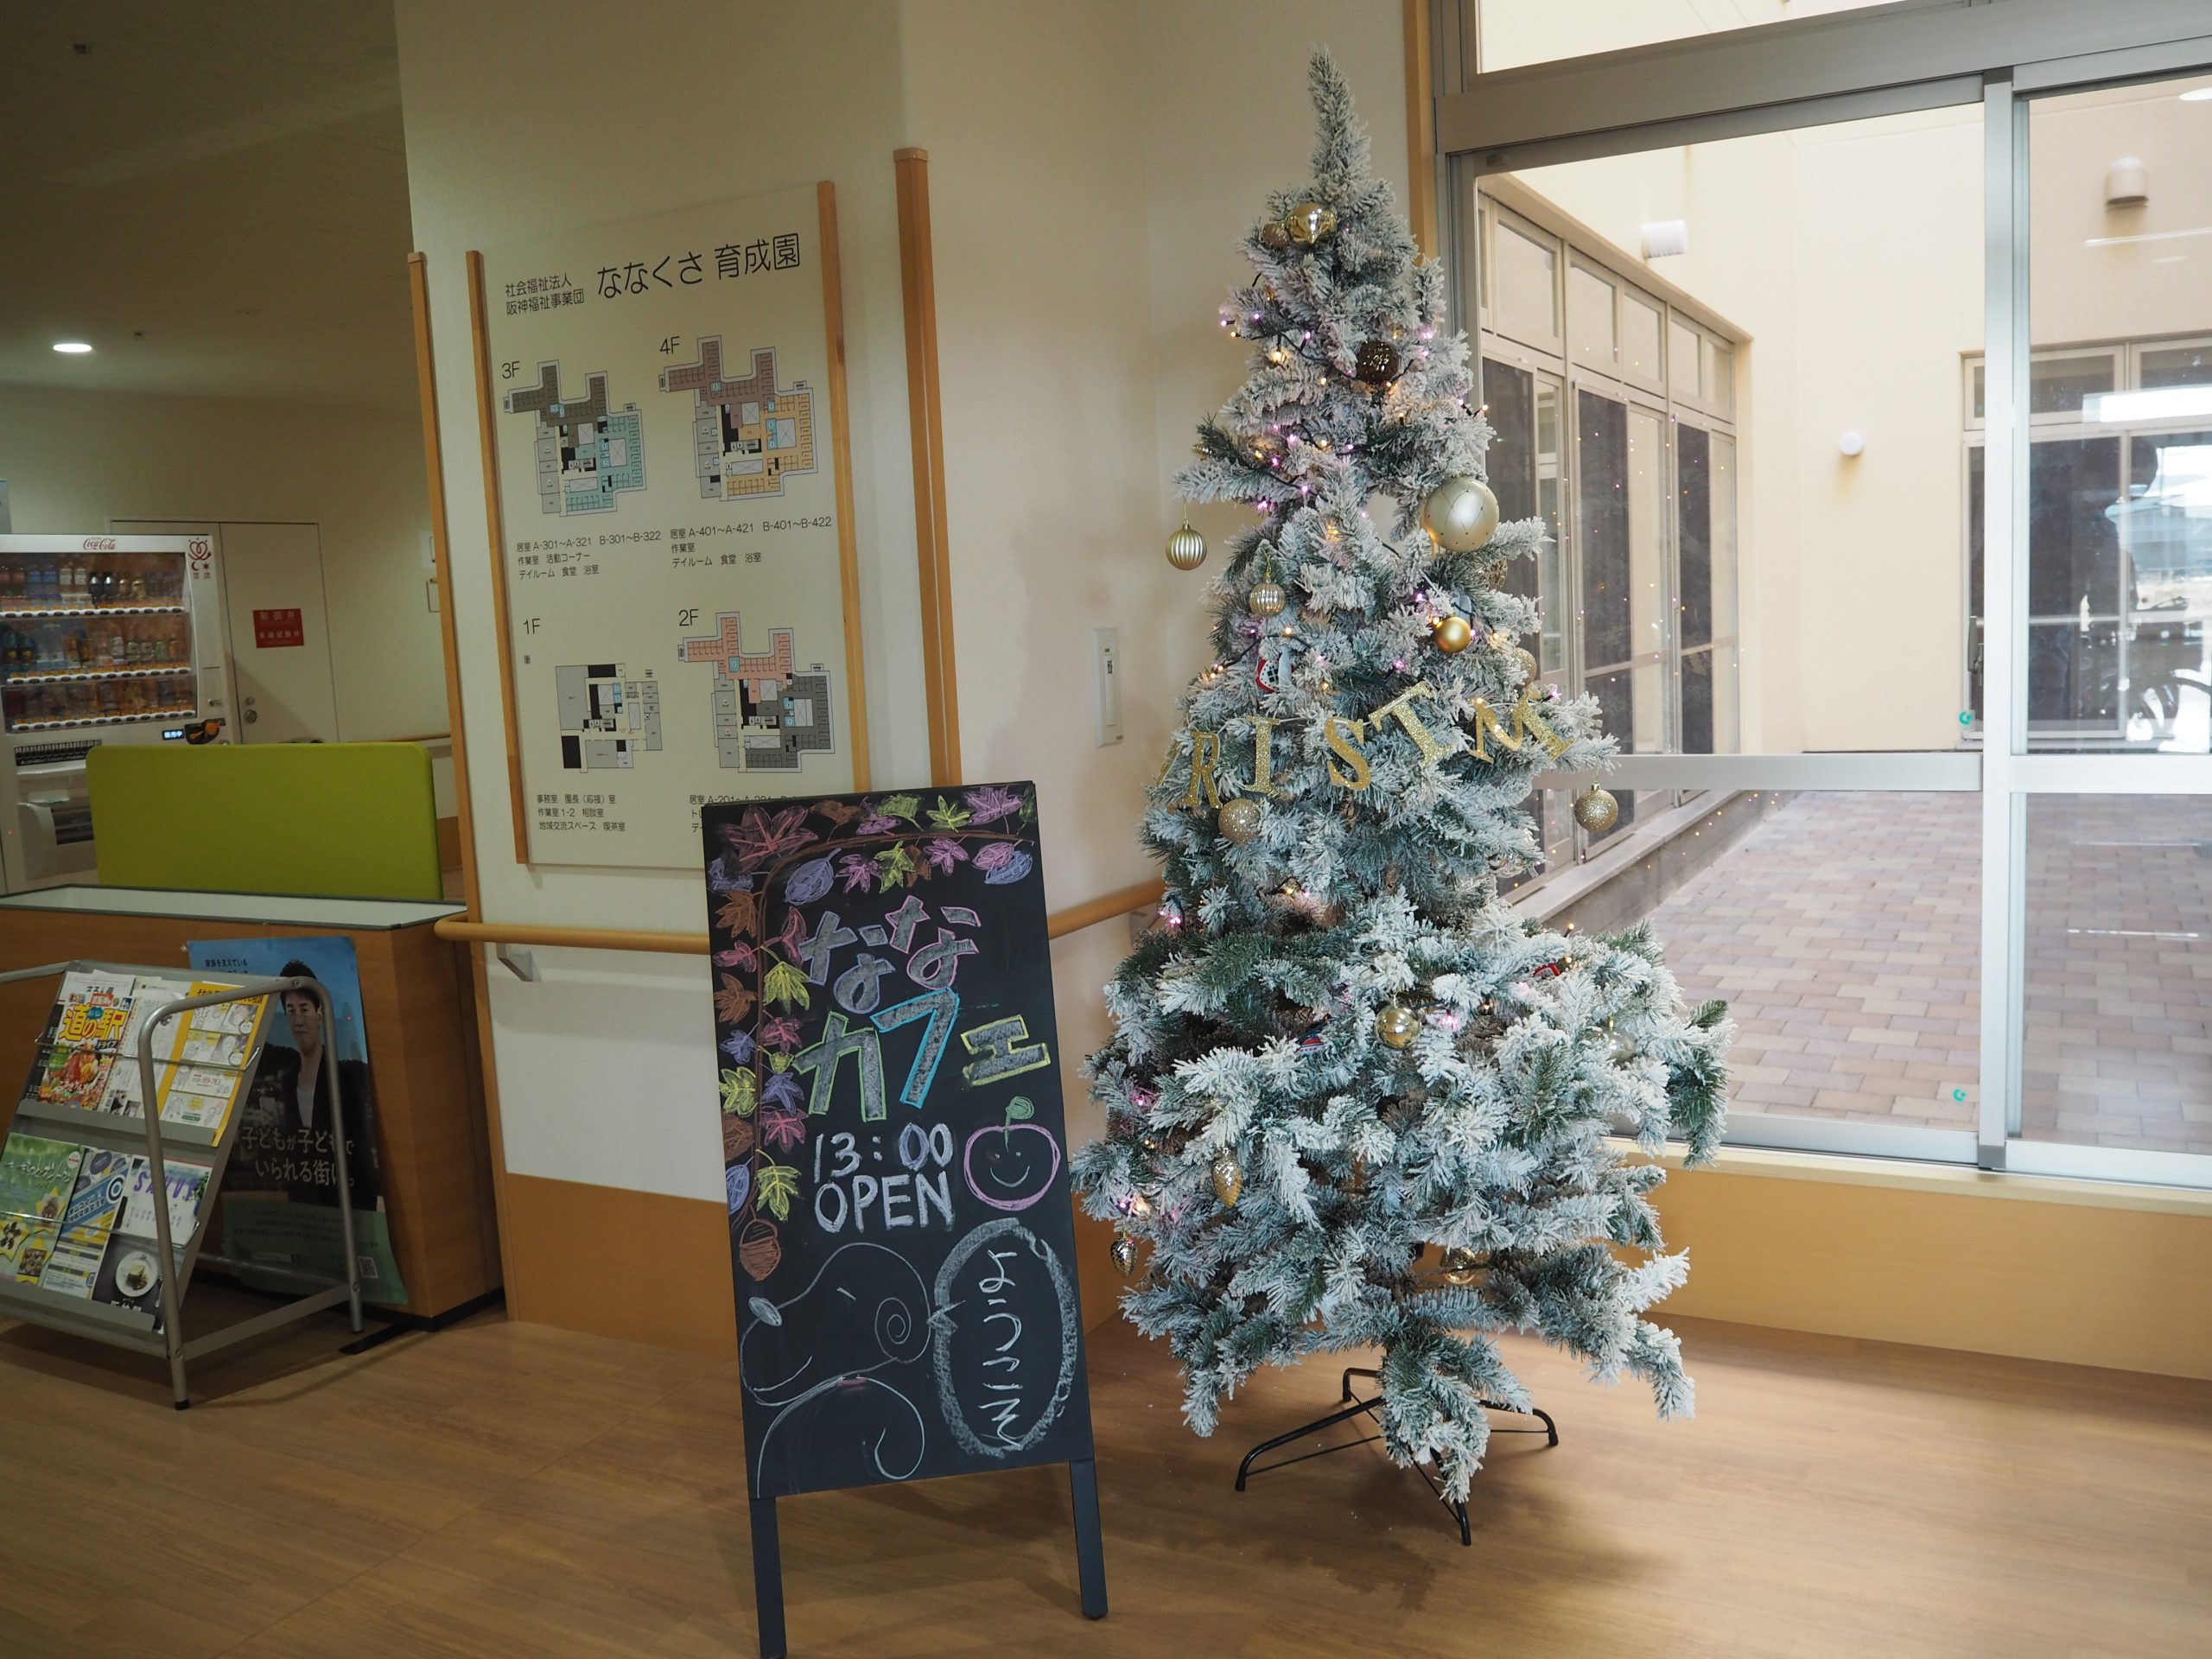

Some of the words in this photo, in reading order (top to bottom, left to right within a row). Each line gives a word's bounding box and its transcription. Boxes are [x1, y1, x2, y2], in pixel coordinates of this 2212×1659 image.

[597, 251, 703, 298] ななくさ
[715, 232, 800, 280] 育成園
[505, 272, 572, 298] 社会福祉法人
[505, 288, 585, 316] 阪神福祉事業団
[659, 336, 681, 355] 4F
[501, 361, 520, 379] 3F
[671, 542, 696, 553] 作業室
[518, 555, 539, 566] 作業室
[546, 552, 591, 564] 活動コーナー
[720, 553, 737, 565] 食堂
[745, 551, 762, 563] 浴室
[562, 566, 577, 577] 食堂
[583, 564, 600, 575] 浴室
[523, 619, 540, 635] 1F
[678, 609, 698, 626] 2F
[537, 794, 558, 804] 事務室
[539, 821, 596, 831] 地域交流スペース
[798, 895, 982, 1014] なな
[58, 1003, 127, 1041] 道の駅
[791, 988, 1052, 1122] カフェ
[814, 1123, 954, 1183] 13:00
[814, 1171, 954, 1233] OPEN
[978, 1249, 1024, 1449] ようこそ
